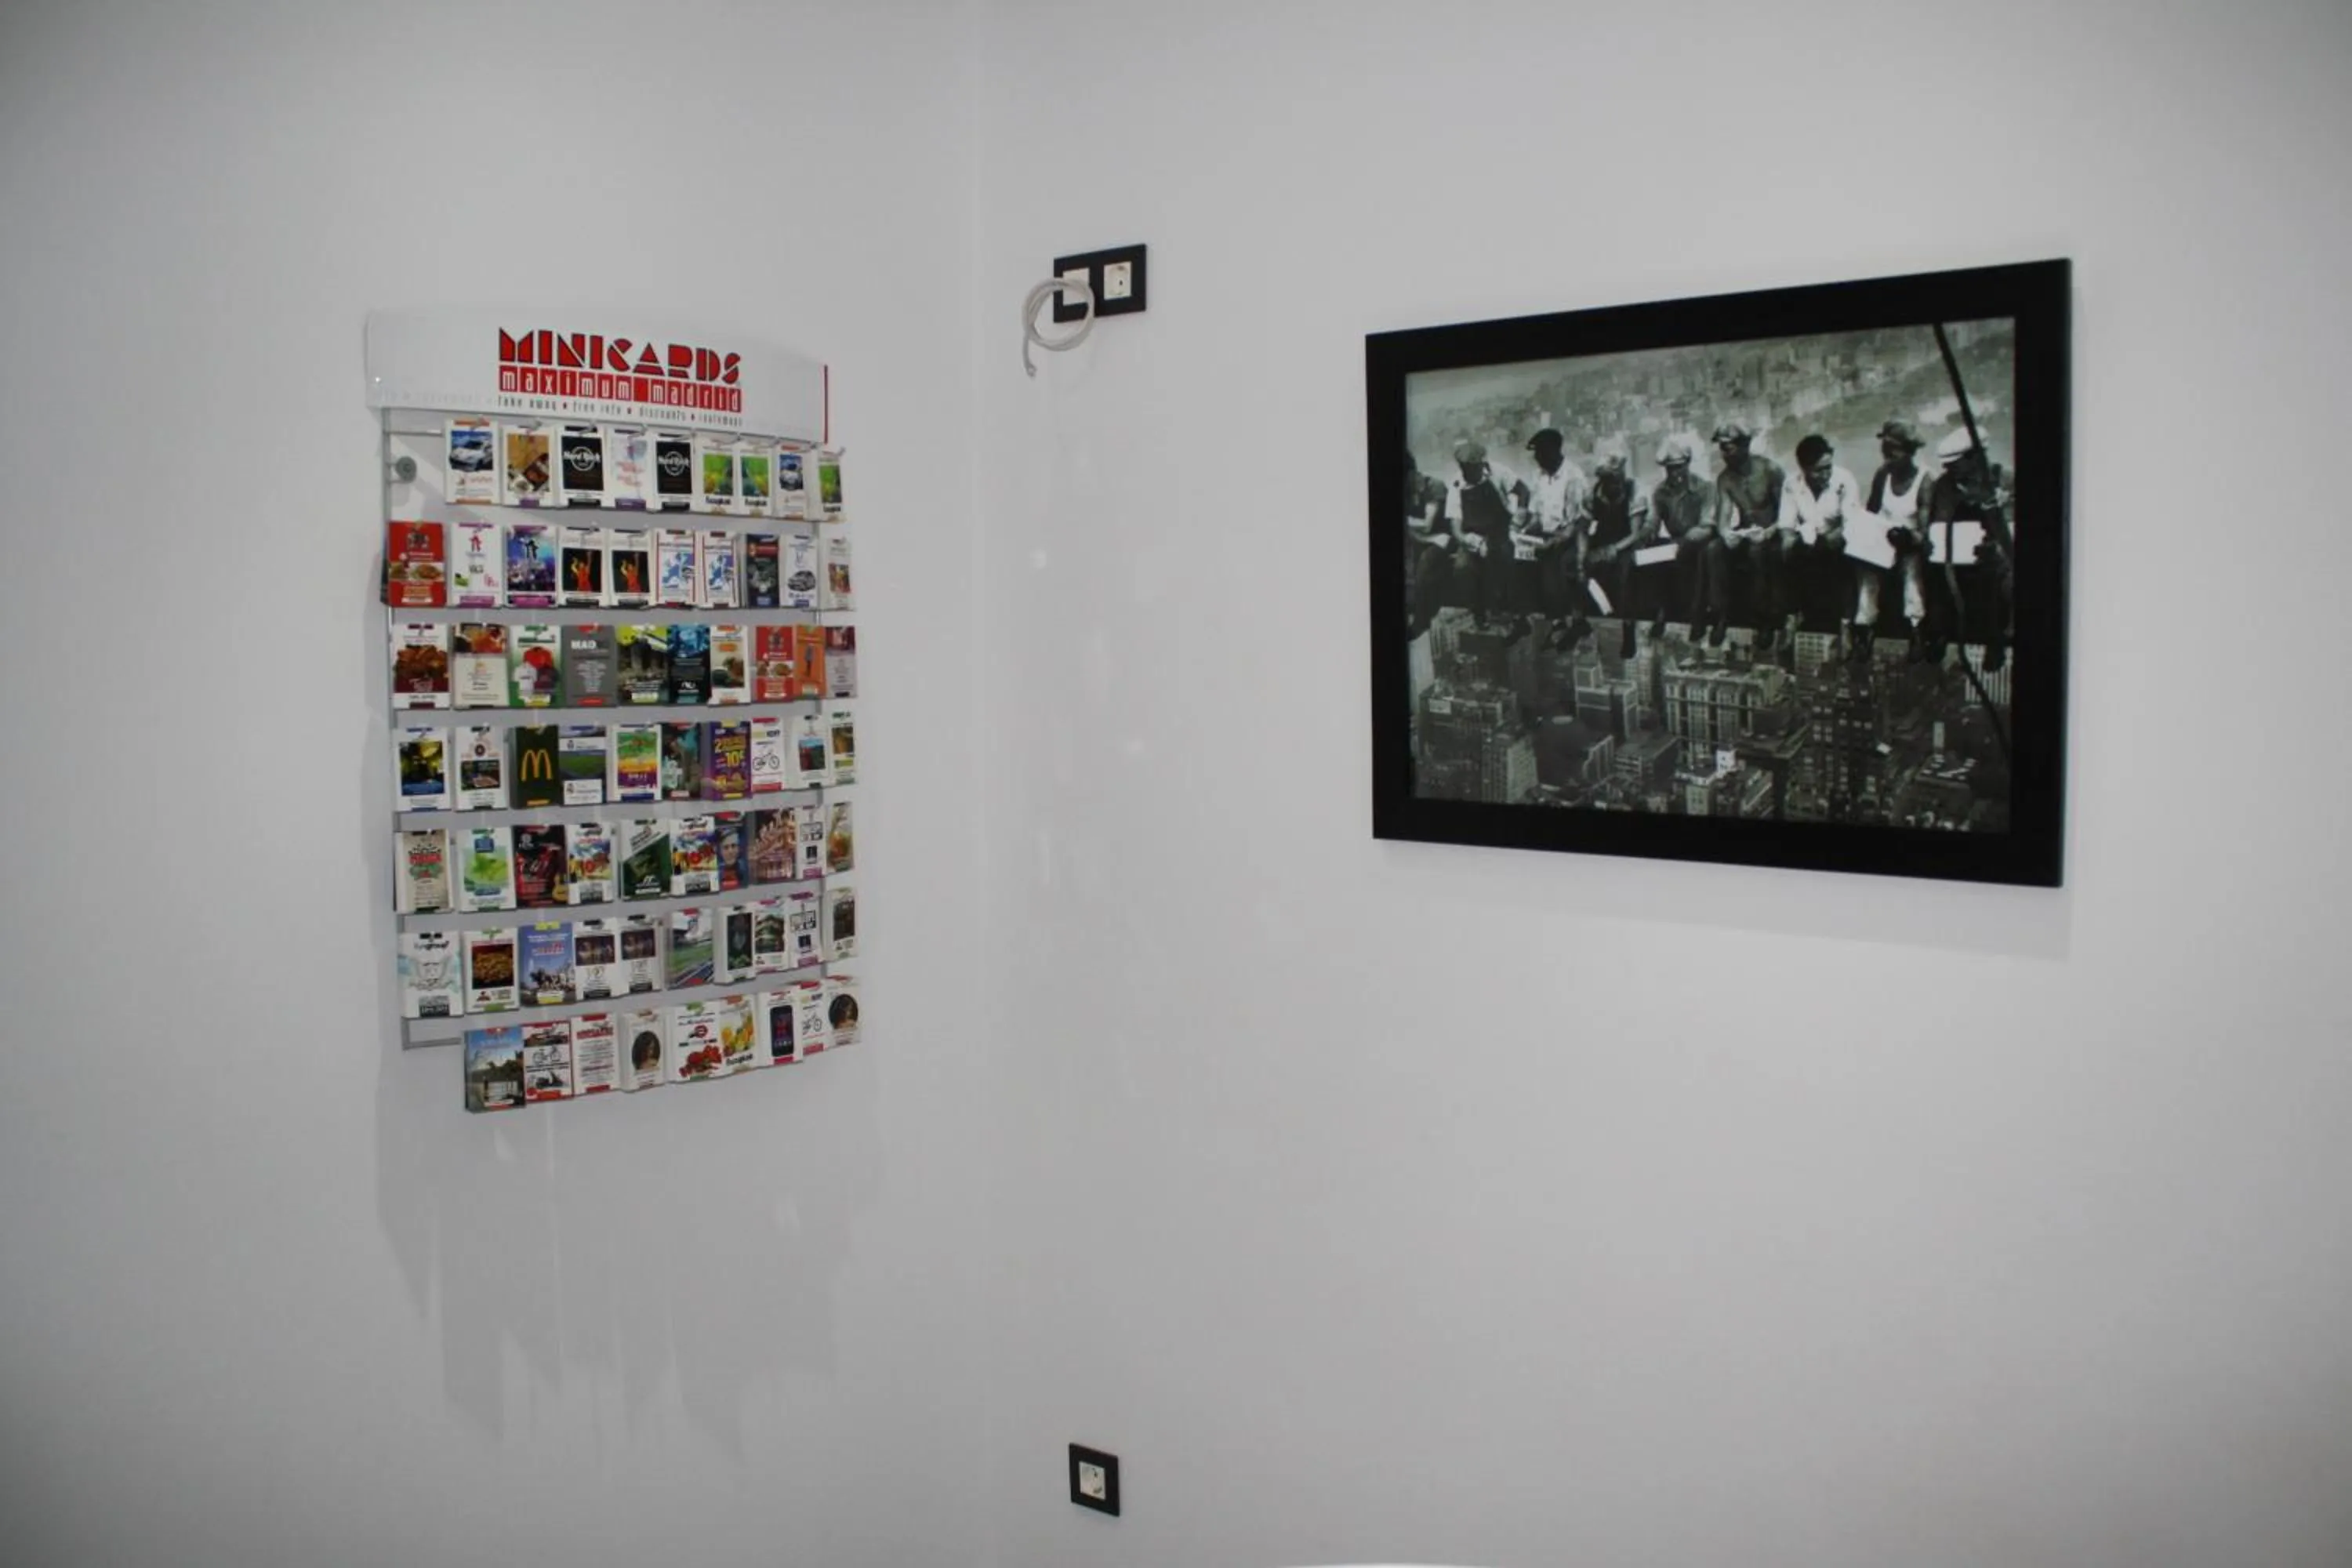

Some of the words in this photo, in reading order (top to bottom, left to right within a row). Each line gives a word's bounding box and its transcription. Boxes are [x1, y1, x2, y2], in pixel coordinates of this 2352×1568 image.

[499, 326, 741, 384] MINICARDS
[501, 370, 631, 400] maximum
[652, 383, 739, 412] madrid
